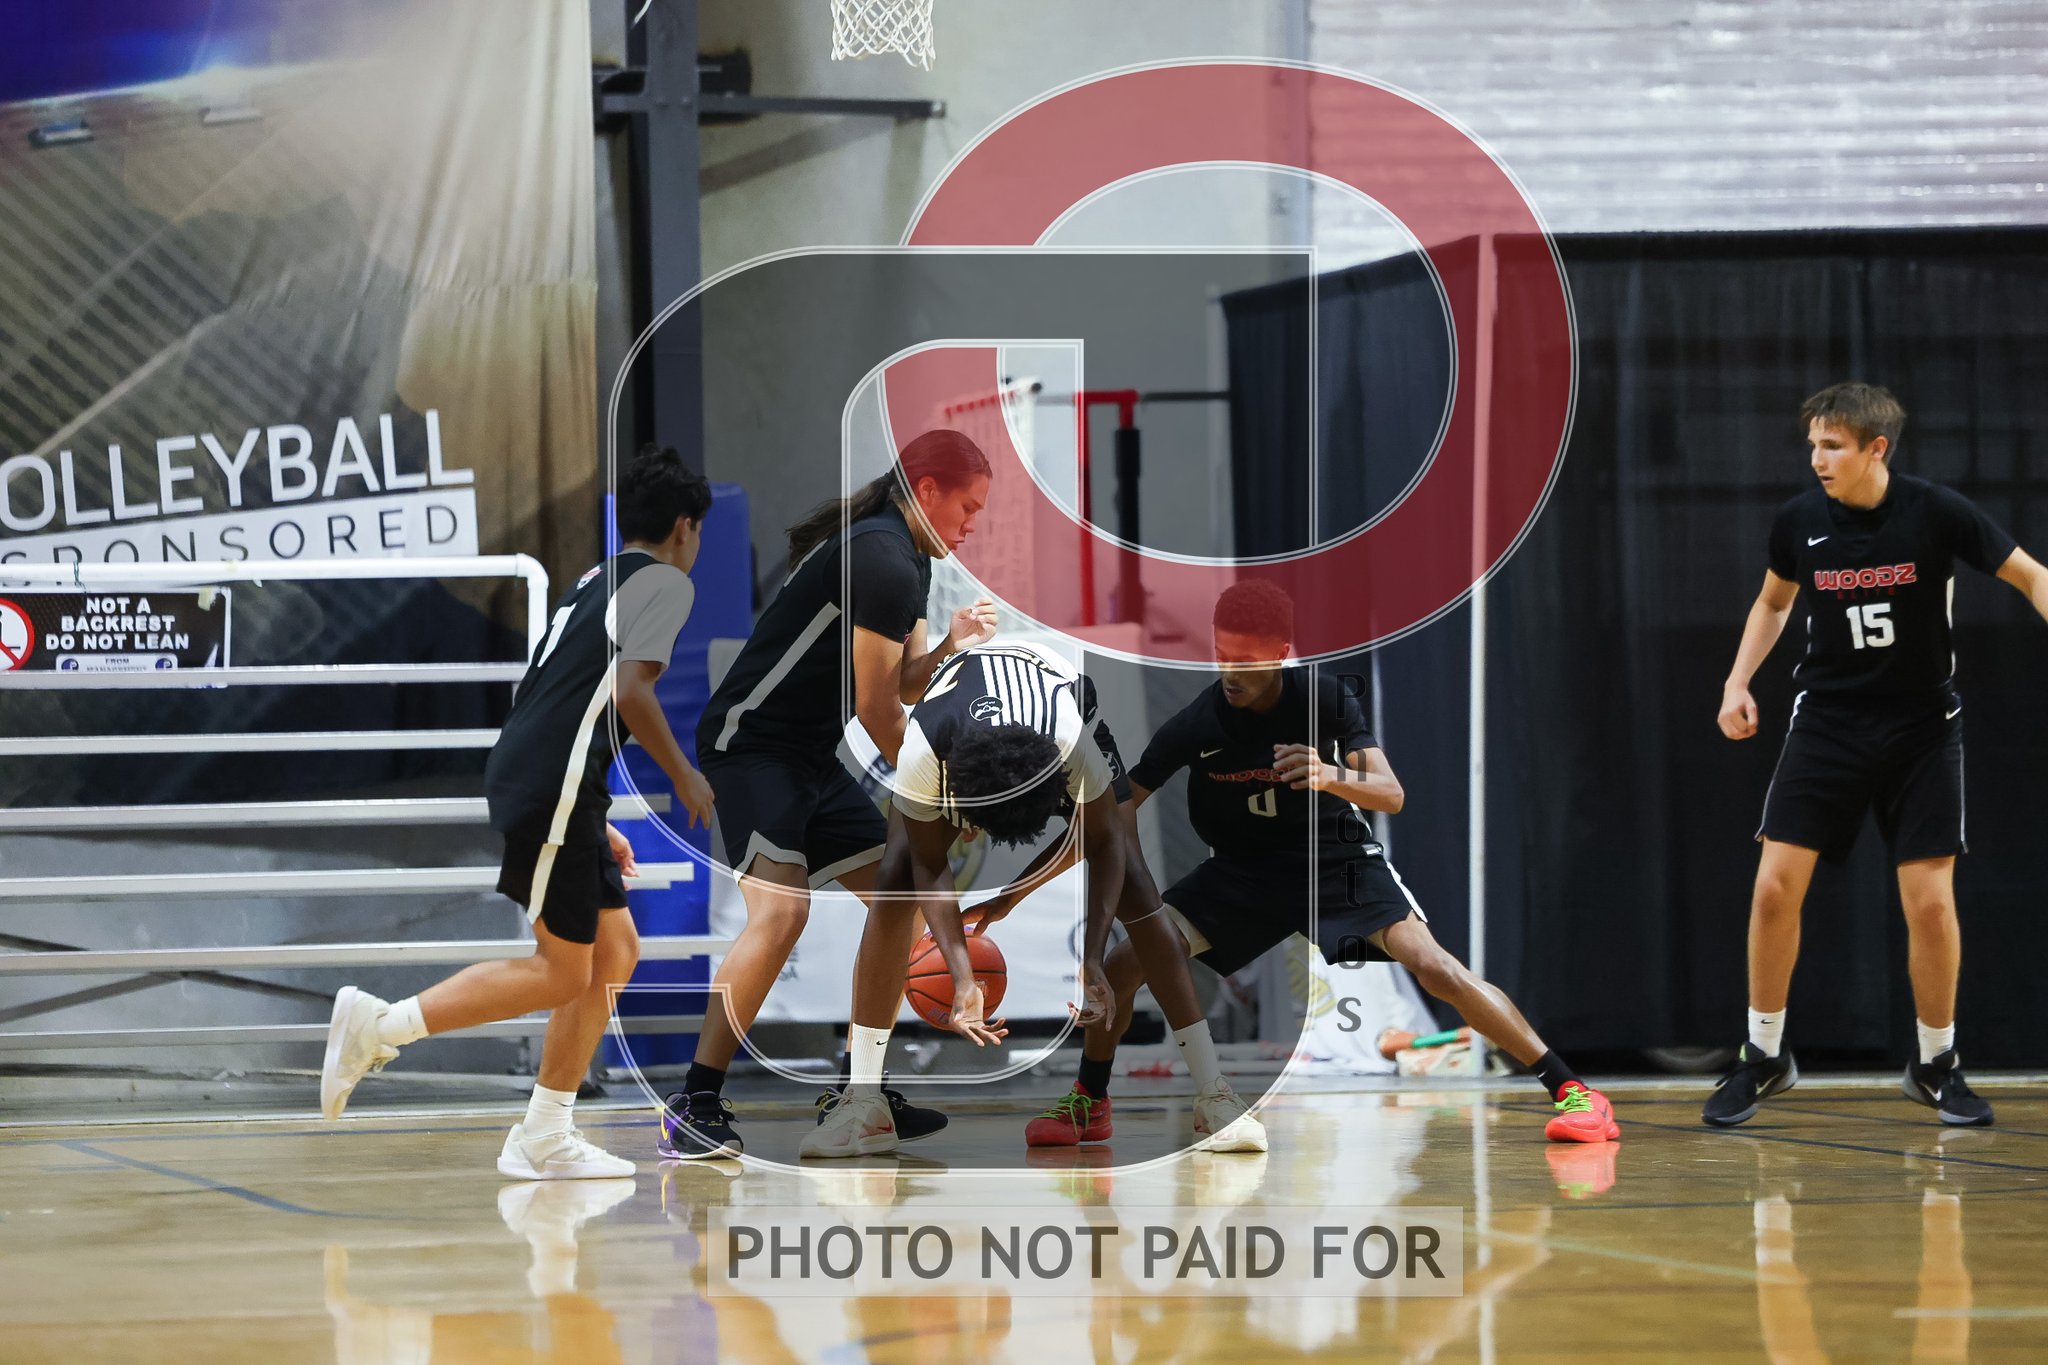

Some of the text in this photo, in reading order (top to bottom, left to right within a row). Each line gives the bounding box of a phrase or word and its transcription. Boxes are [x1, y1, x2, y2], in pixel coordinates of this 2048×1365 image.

[1815, 563, 1917, 590] WOODZ
[86, 597, 151, 614] NOT A
[61, 615, 175, 632] BACKREST
[1846, 602, 1896, 650] 15
[45, 633, 189, 650] DO NOT LEAN
